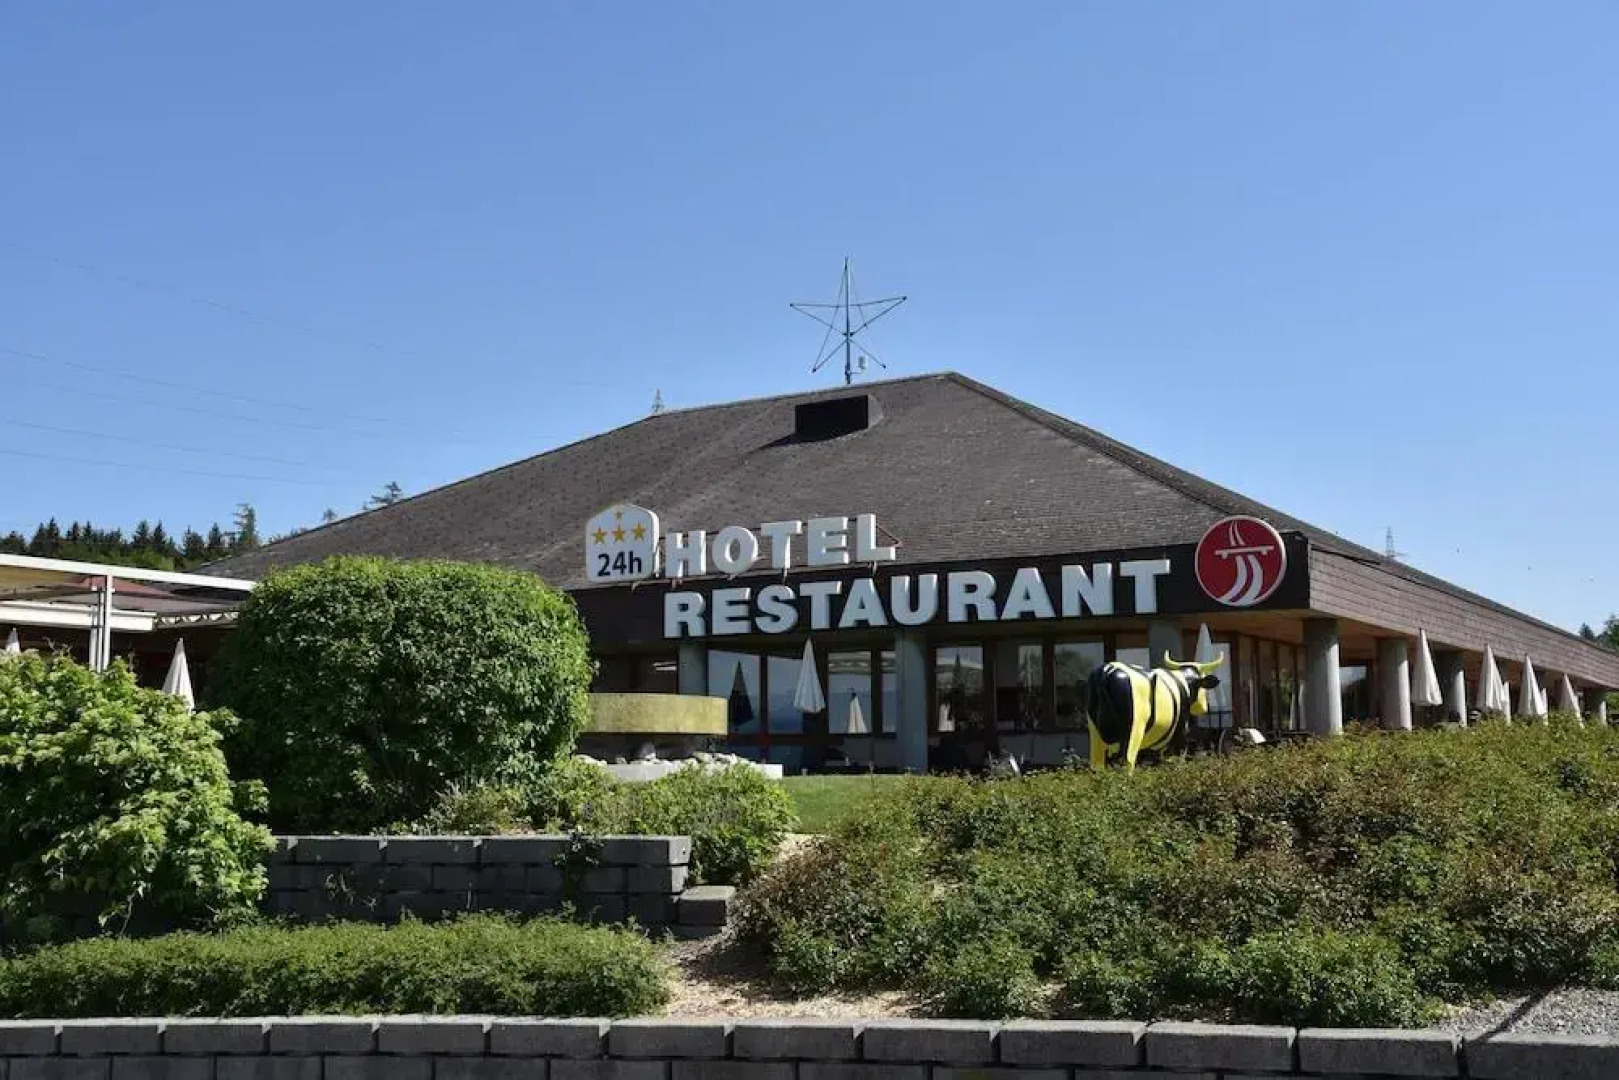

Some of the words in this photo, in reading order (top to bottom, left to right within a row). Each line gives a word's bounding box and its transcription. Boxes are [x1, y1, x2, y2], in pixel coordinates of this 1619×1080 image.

[597, 550, 642, 577] 24h
[664, 512, 896, 579] HOTEL
[663, 558, 1171, 639] RESTAURANT
